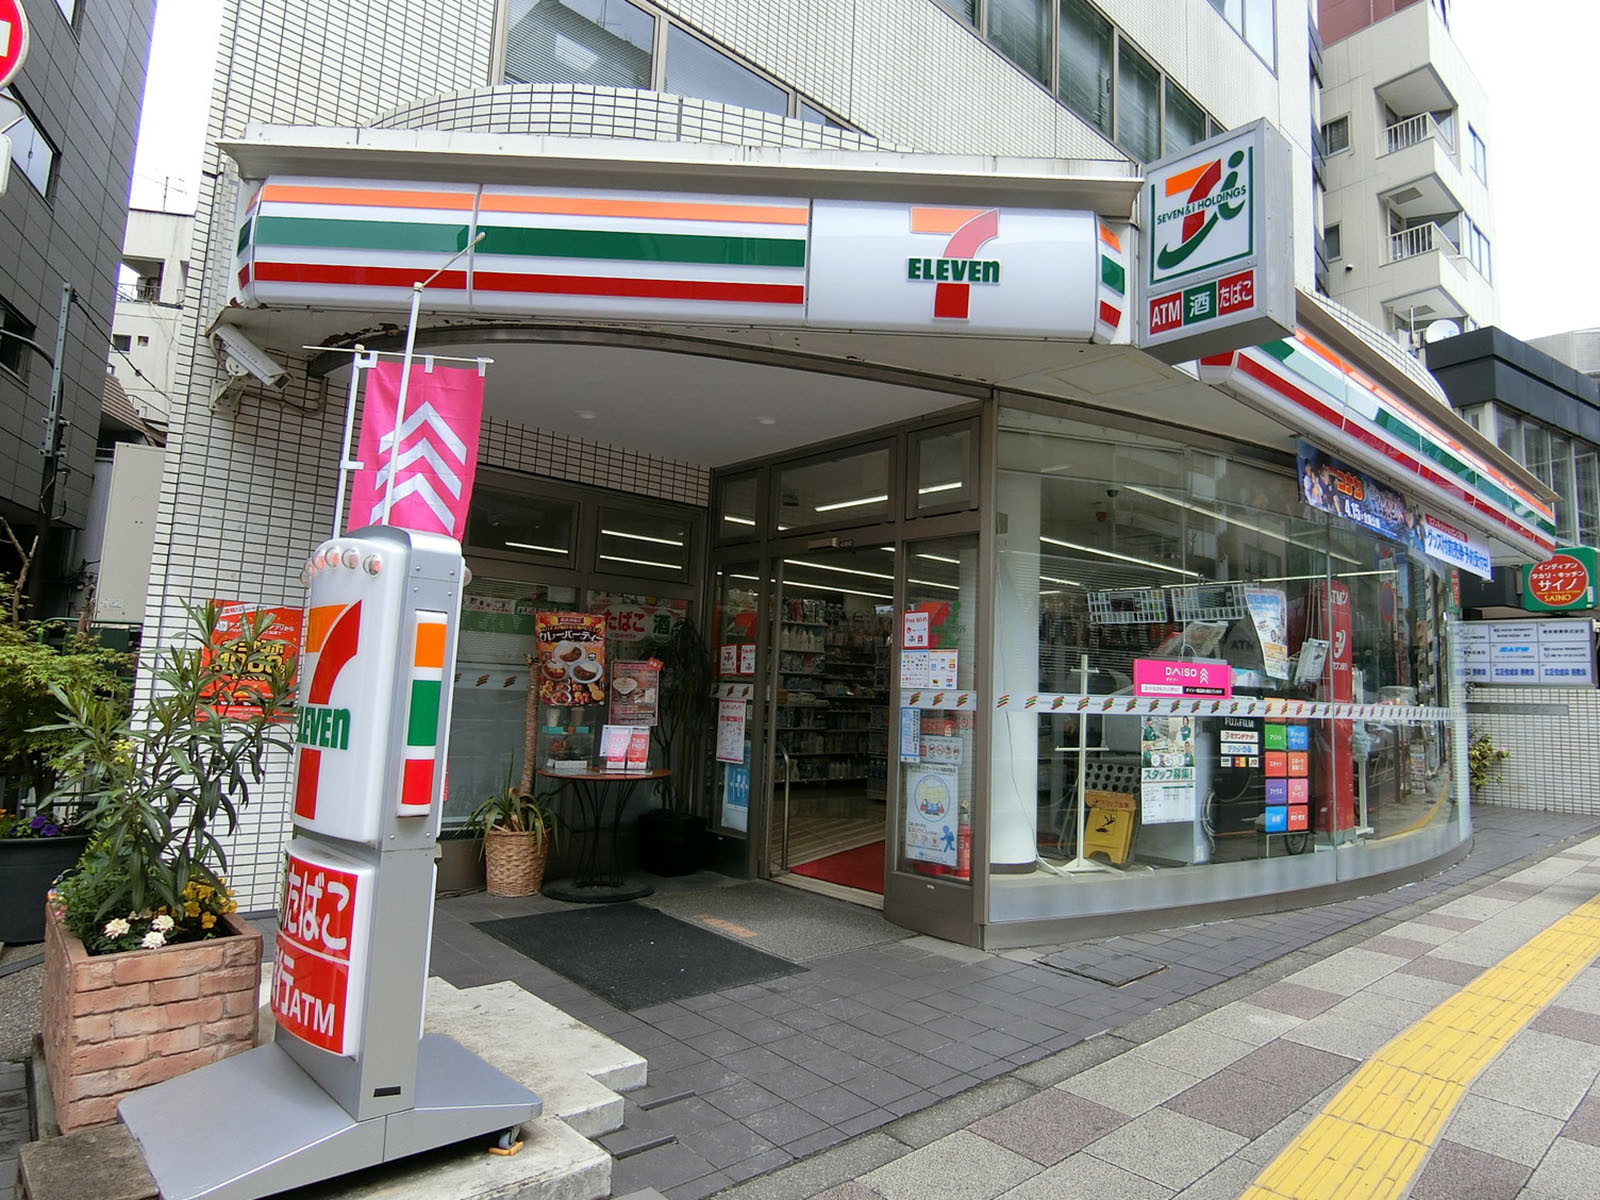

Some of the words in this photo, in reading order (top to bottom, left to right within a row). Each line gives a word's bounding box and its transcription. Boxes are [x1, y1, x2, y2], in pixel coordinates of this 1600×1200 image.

[1197, 185, 1247, 211] HOLDINGS
[1151, 300, 1181, 327] ATM
[1189, 291, 1211, 318] 酒
[1219, 280, 1253, 307] たばこ
[1538, 578, 1577, 592] サイノ
[1544, 594, 1572, 602] SAINO
[604, 609, 646, 634] たばこ
[653, 613, 671, 635] 酒
[1165, 666, 1197, 677] DAISO
[1143, 767, 1193, 780] スタッフ募集!
[283, 863, 350, 950] たばこ
